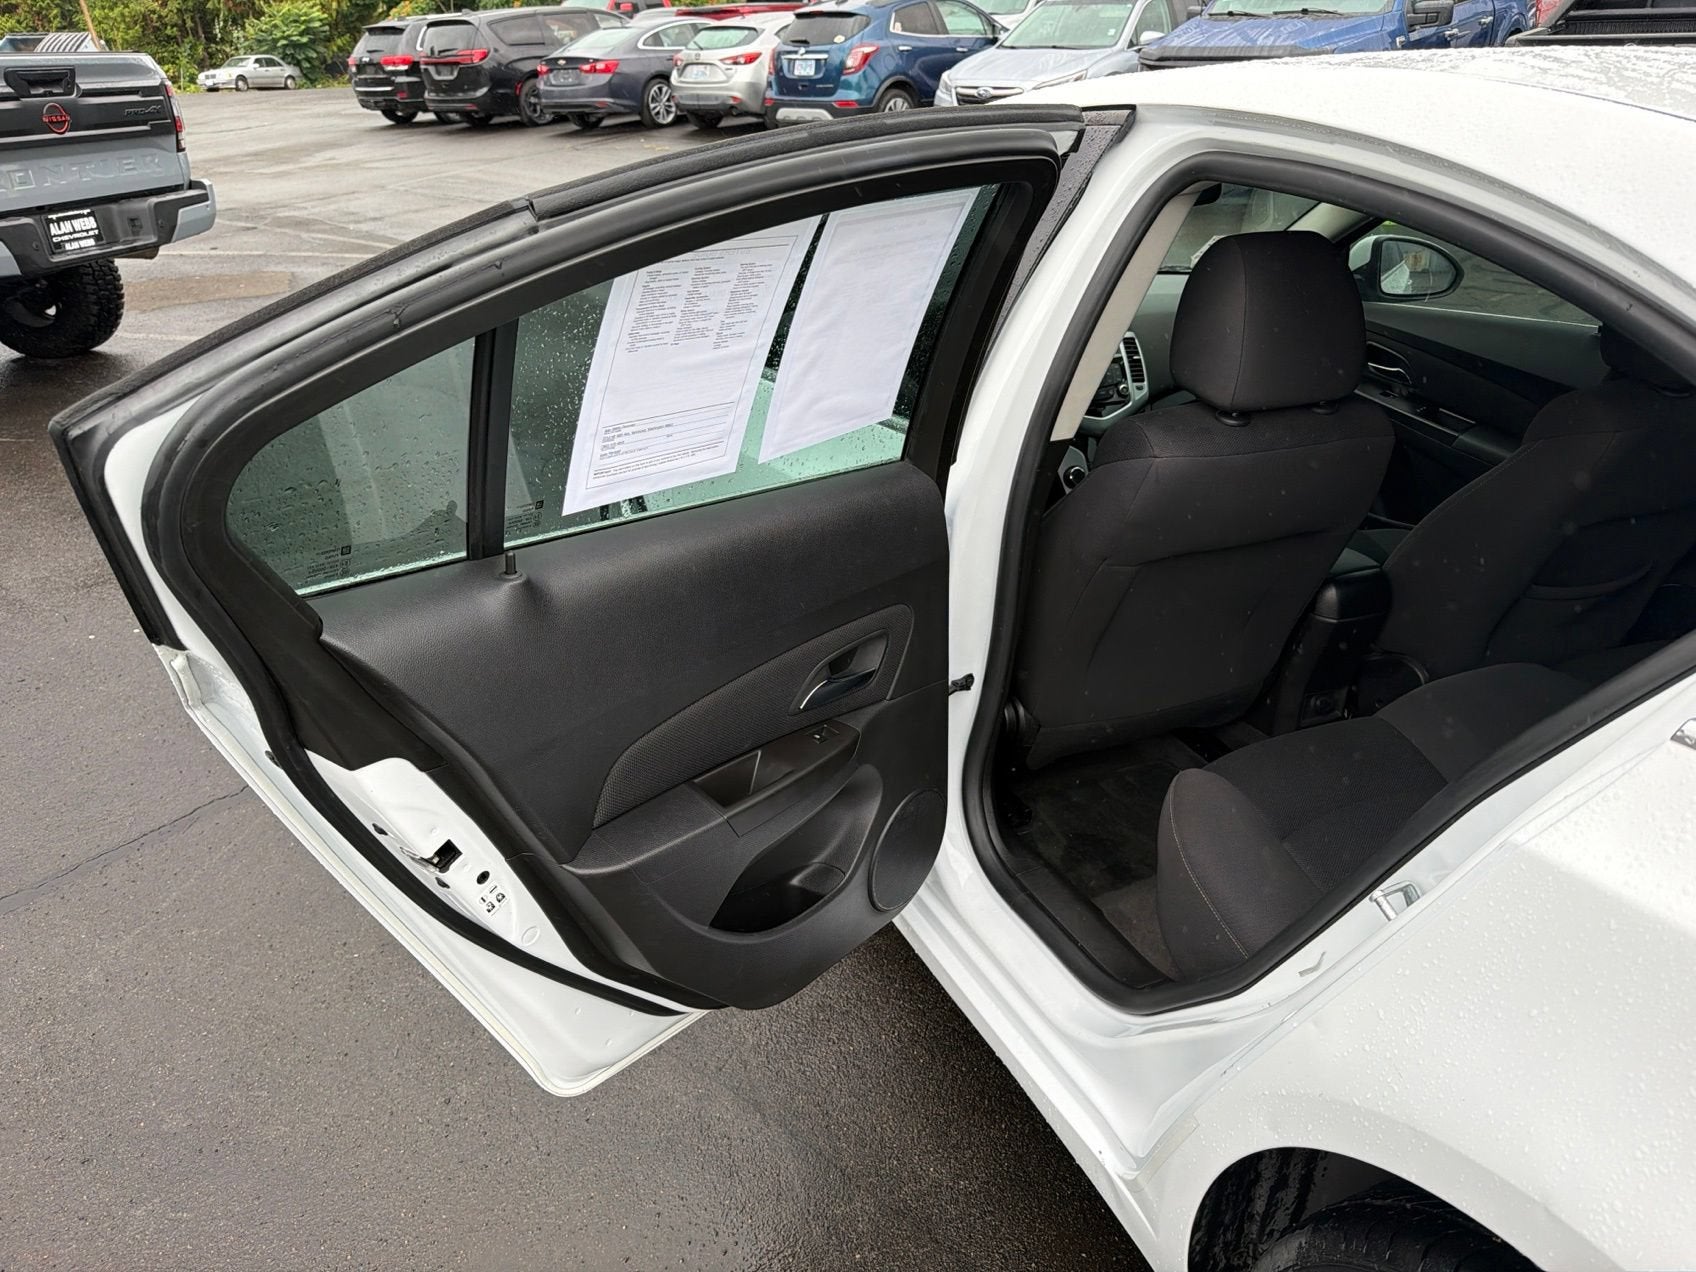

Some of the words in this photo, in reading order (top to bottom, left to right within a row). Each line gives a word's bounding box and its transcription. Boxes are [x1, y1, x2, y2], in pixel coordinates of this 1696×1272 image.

[42, 113, 71, 123] NISSAN
[50, 220, 73, 236] ALAN
[71, 216, 97, 232] WEBB
[52, 229, 99, 243] CHEVROLET
